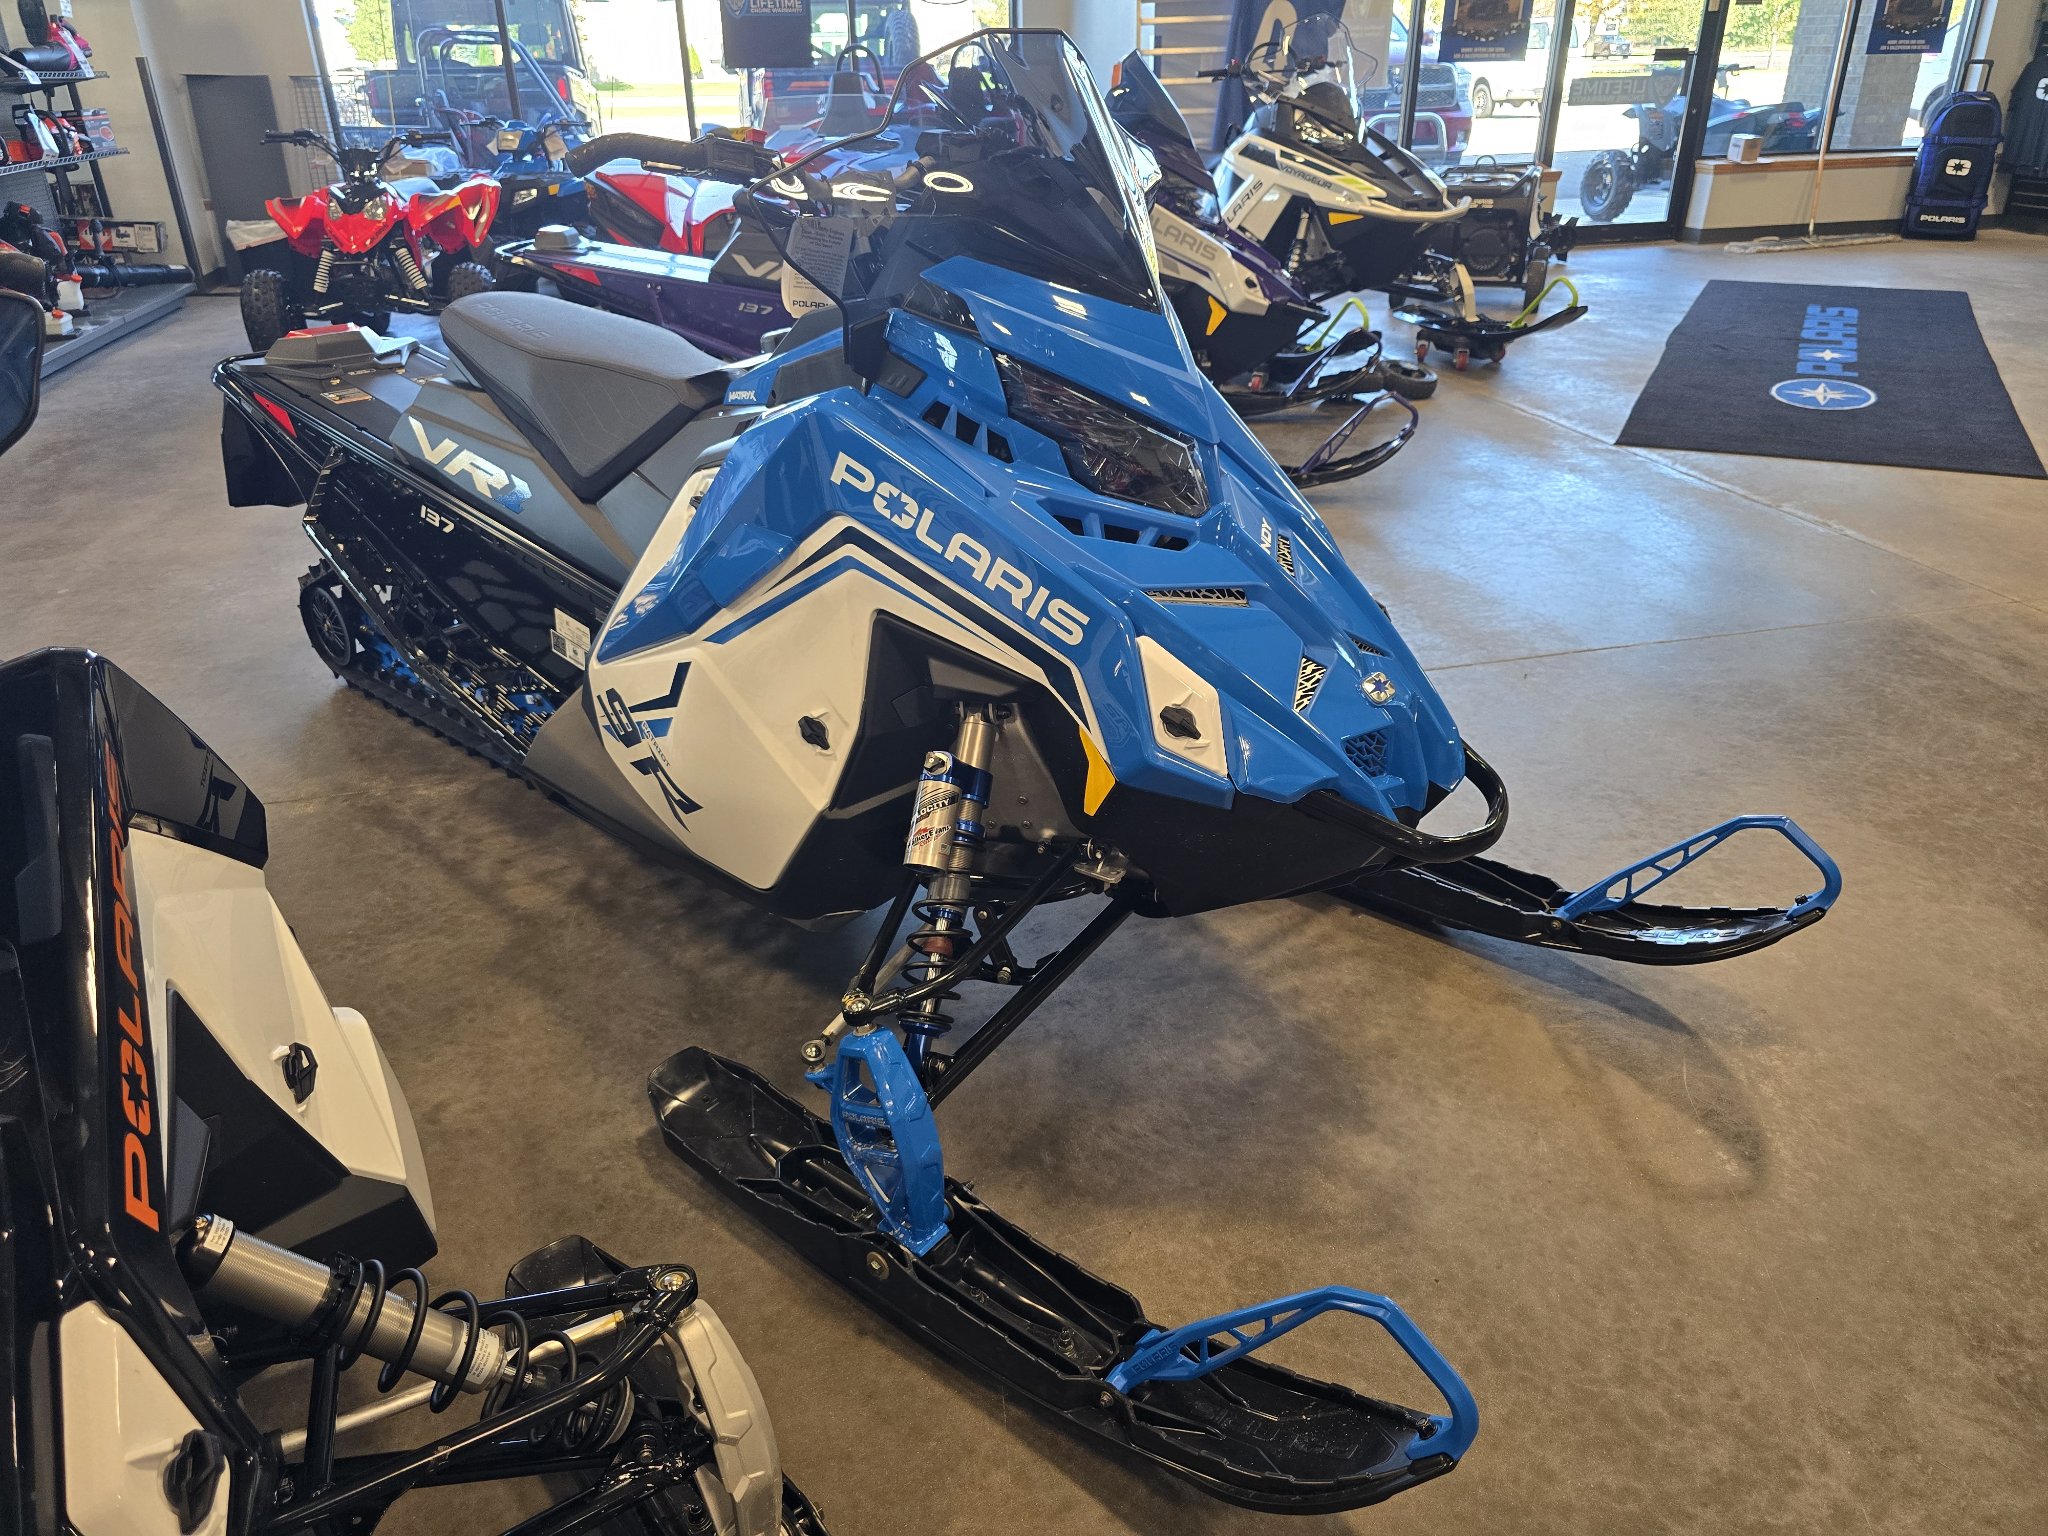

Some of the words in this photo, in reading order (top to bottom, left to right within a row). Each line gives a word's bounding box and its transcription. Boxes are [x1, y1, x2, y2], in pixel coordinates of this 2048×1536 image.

[750, 0, 802, 8] LIFETIME
[1280, 163, 1333, 190] VOYAGEUR
[1225, 178, 1265, 223] LARIS
[1920, 214, 1966, 224] POLARIS
[1153, 217, 1219, 262] LARIS
[731, 253, 783, 280] V
[738, 302, 773, 315] 137
[792, 299, 829, 309] POLAR
[1796, 304, 1859, 377] POLARIS
[728, 390, 757, 402] MATRYX
[420, 504, 455, 534] 137
[830, 451, 1090, 645] POLARIS
[1260, 516, 1272, 556] NDY
[641, 720, 671, 767] PATRIOT
[914, 798, 950, 820] LOCITY
[105, 738, 159, 1232] POLARIS
